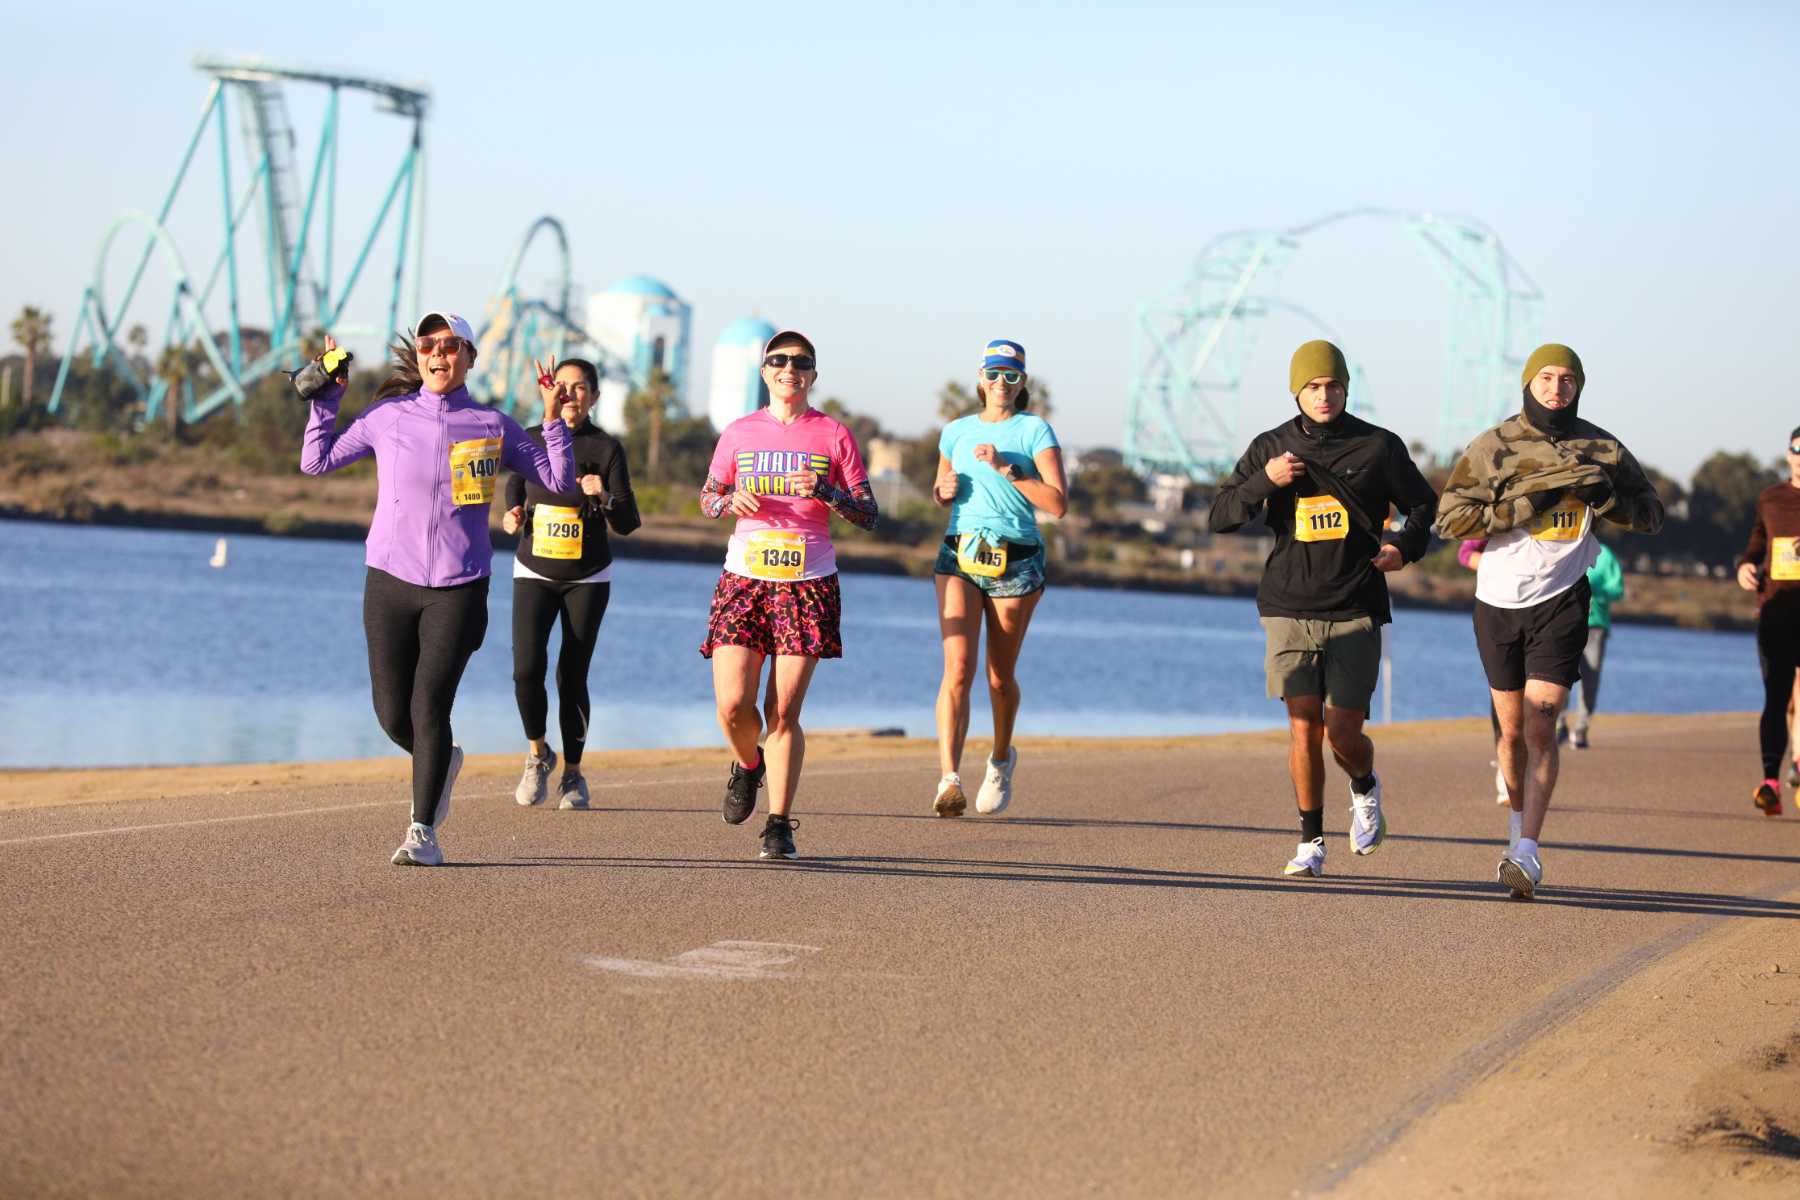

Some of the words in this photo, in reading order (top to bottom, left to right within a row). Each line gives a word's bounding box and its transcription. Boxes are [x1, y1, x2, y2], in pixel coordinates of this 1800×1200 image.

[1310, 511, 1342, 530] 1112
[547, 523, 580, 538] 1298
[761, 549, 802, 567] 1349
